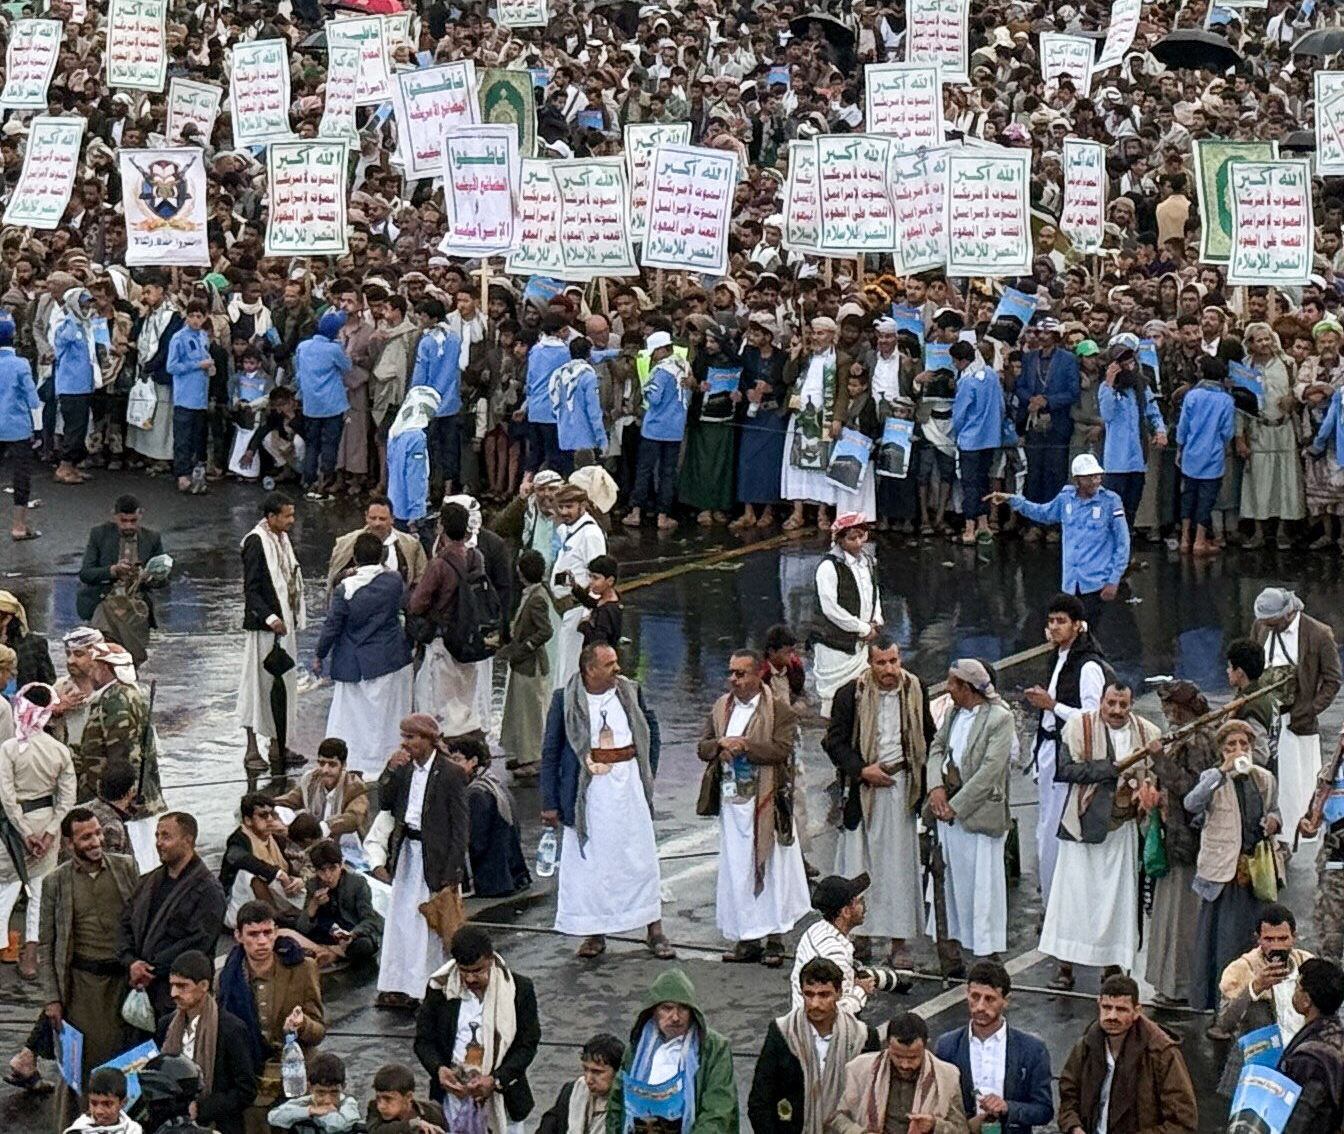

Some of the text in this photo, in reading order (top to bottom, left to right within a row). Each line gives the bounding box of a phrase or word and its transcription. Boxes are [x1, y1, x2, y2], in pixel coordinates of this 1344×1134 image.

[316, 148, 340, 165] الله
[451, 145, 506, 170] قاطعوا
[701, 162, 727, 179] الله
[996, 168, 1020, 181] الله
[1277, 167, 1302, 185] الله
